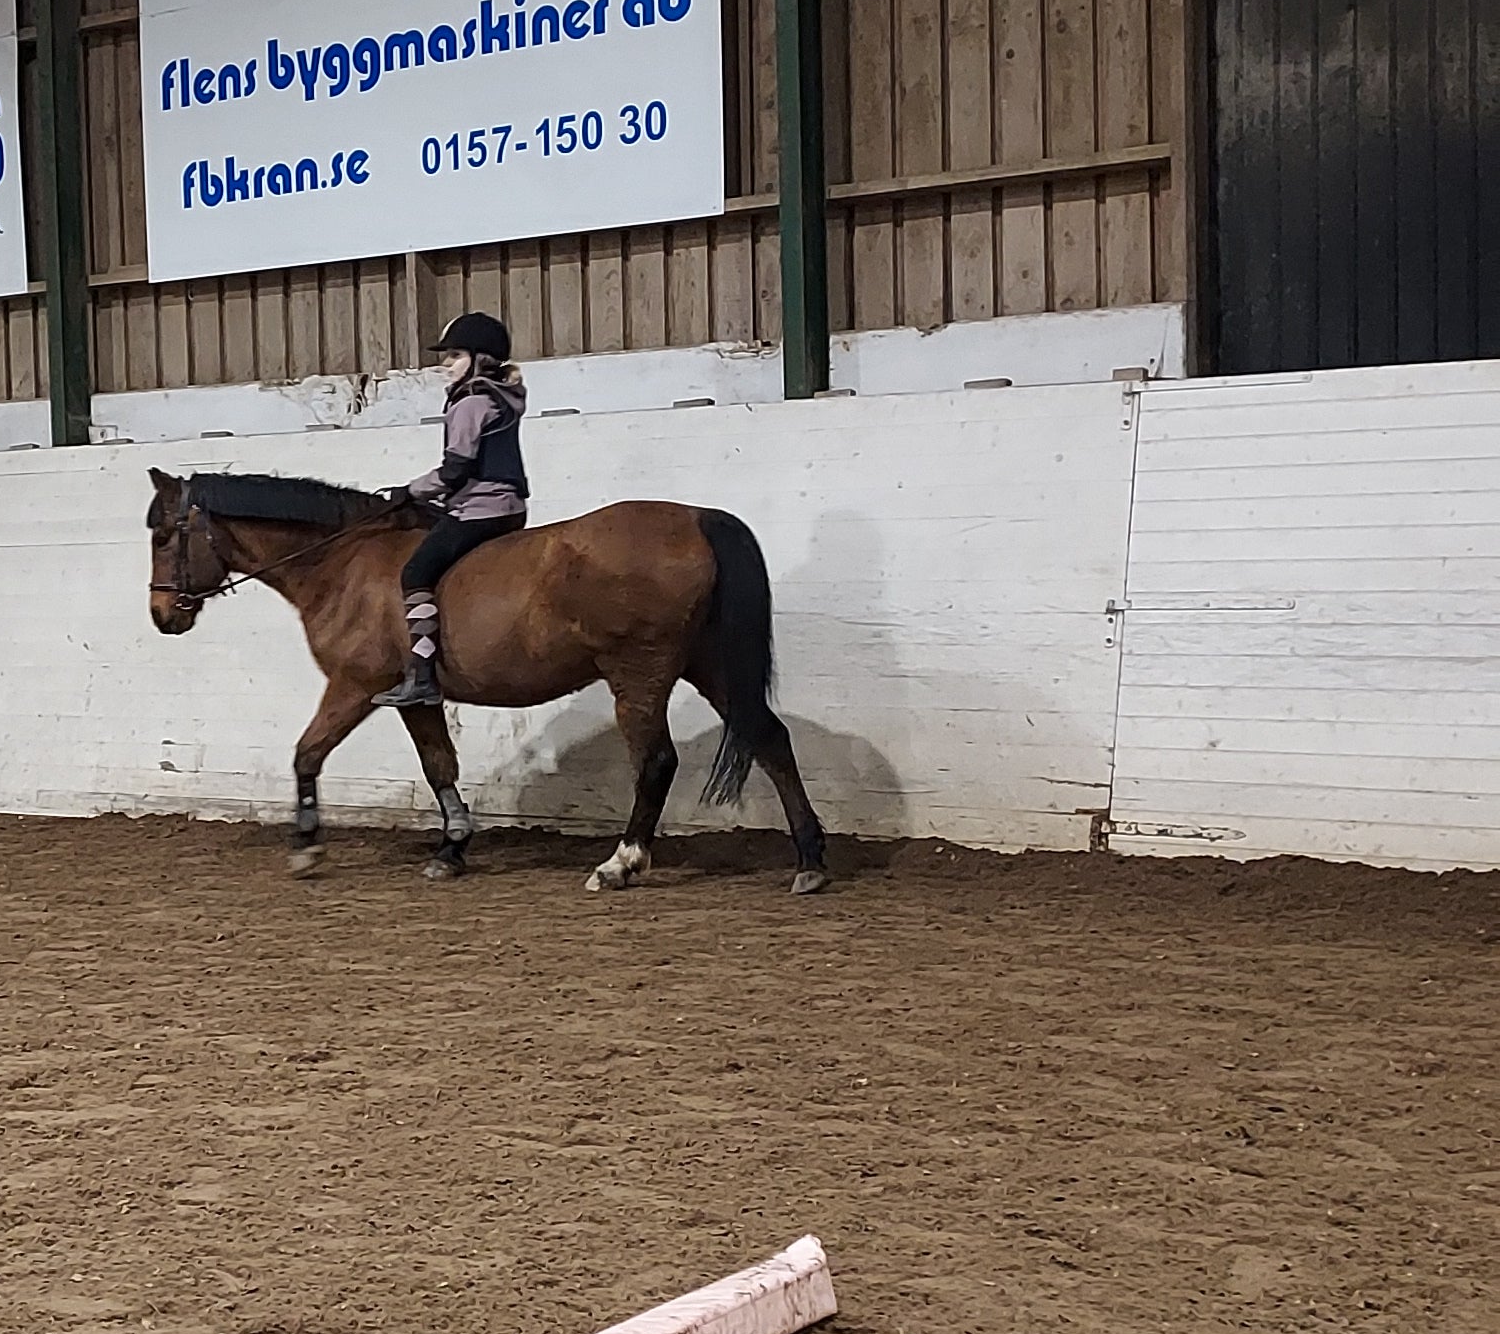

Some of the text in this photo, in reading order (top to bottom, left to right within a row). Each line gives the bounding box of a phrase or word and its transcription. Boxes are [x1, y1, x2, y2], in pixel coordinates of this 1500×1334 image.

[161, 57, 258, 111] flens
[182, 100, 667, 209] fbkran.se 0157-150 30
